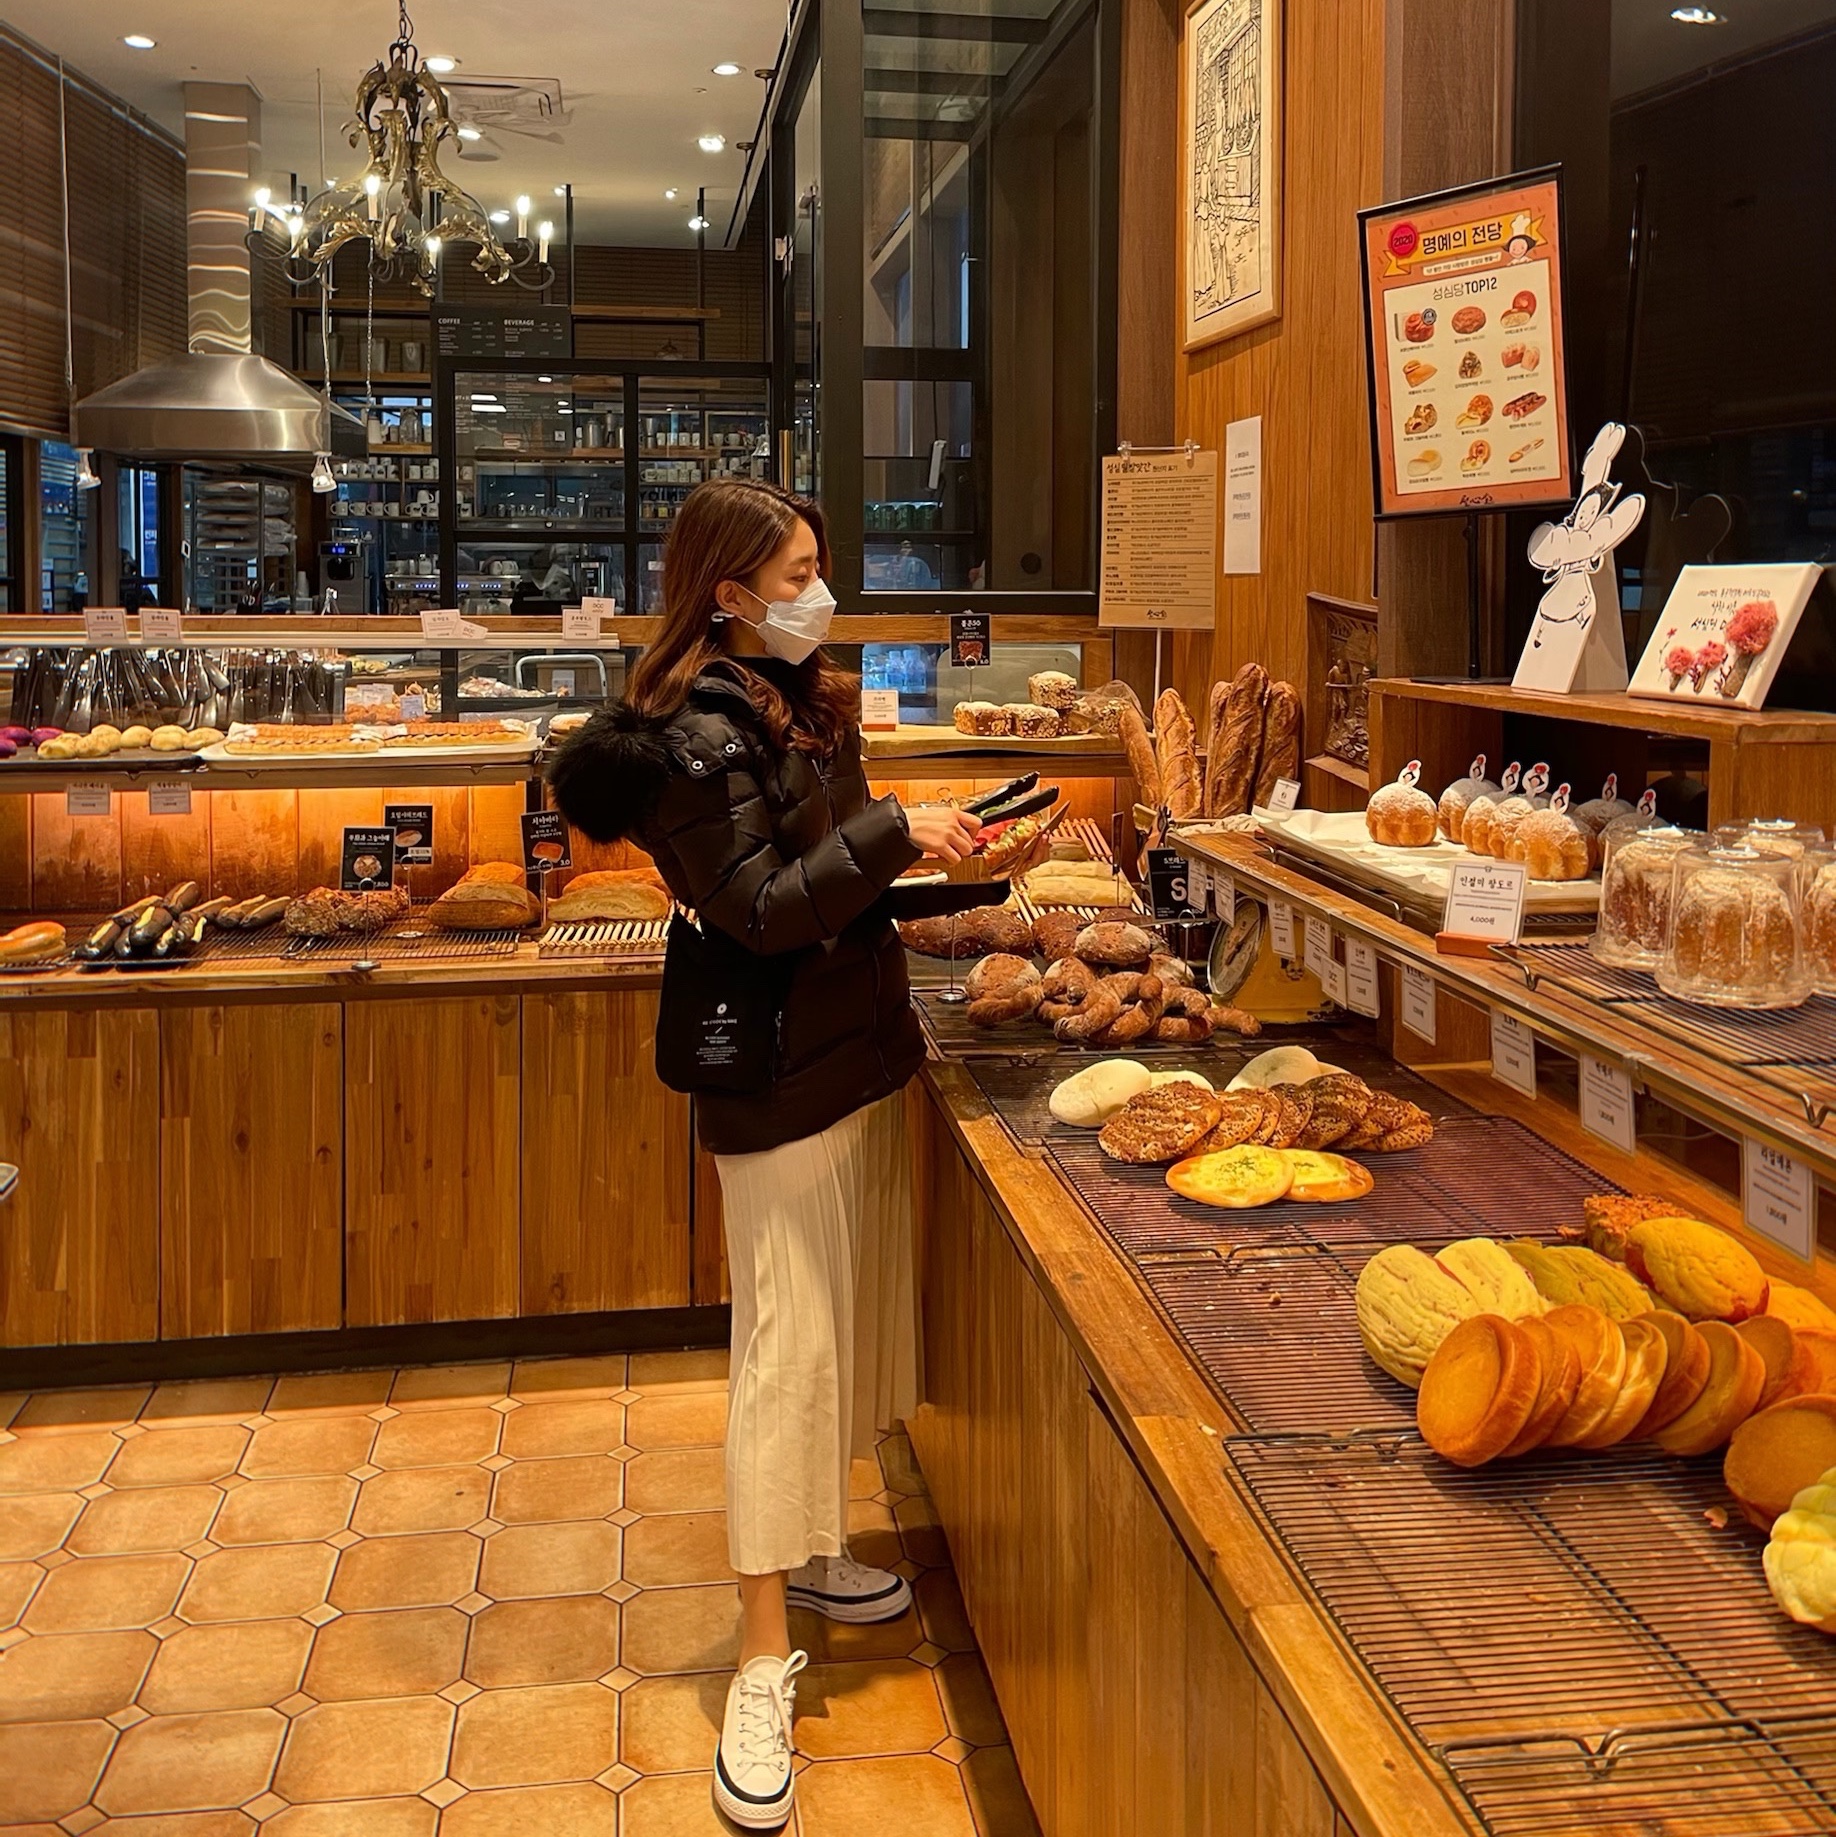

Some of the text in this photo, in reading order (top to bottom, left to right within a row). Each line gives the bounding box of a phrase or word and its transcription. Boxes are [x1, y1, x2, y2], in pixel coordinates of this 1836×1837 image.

[1422, 222, 1503, 255] 명예의 전당
[1171, 877, 1187, 901] S
[1460, 876, 1514, 890] 인절미 팡도르
[1470, 916, 1495, 925] 4,000원
